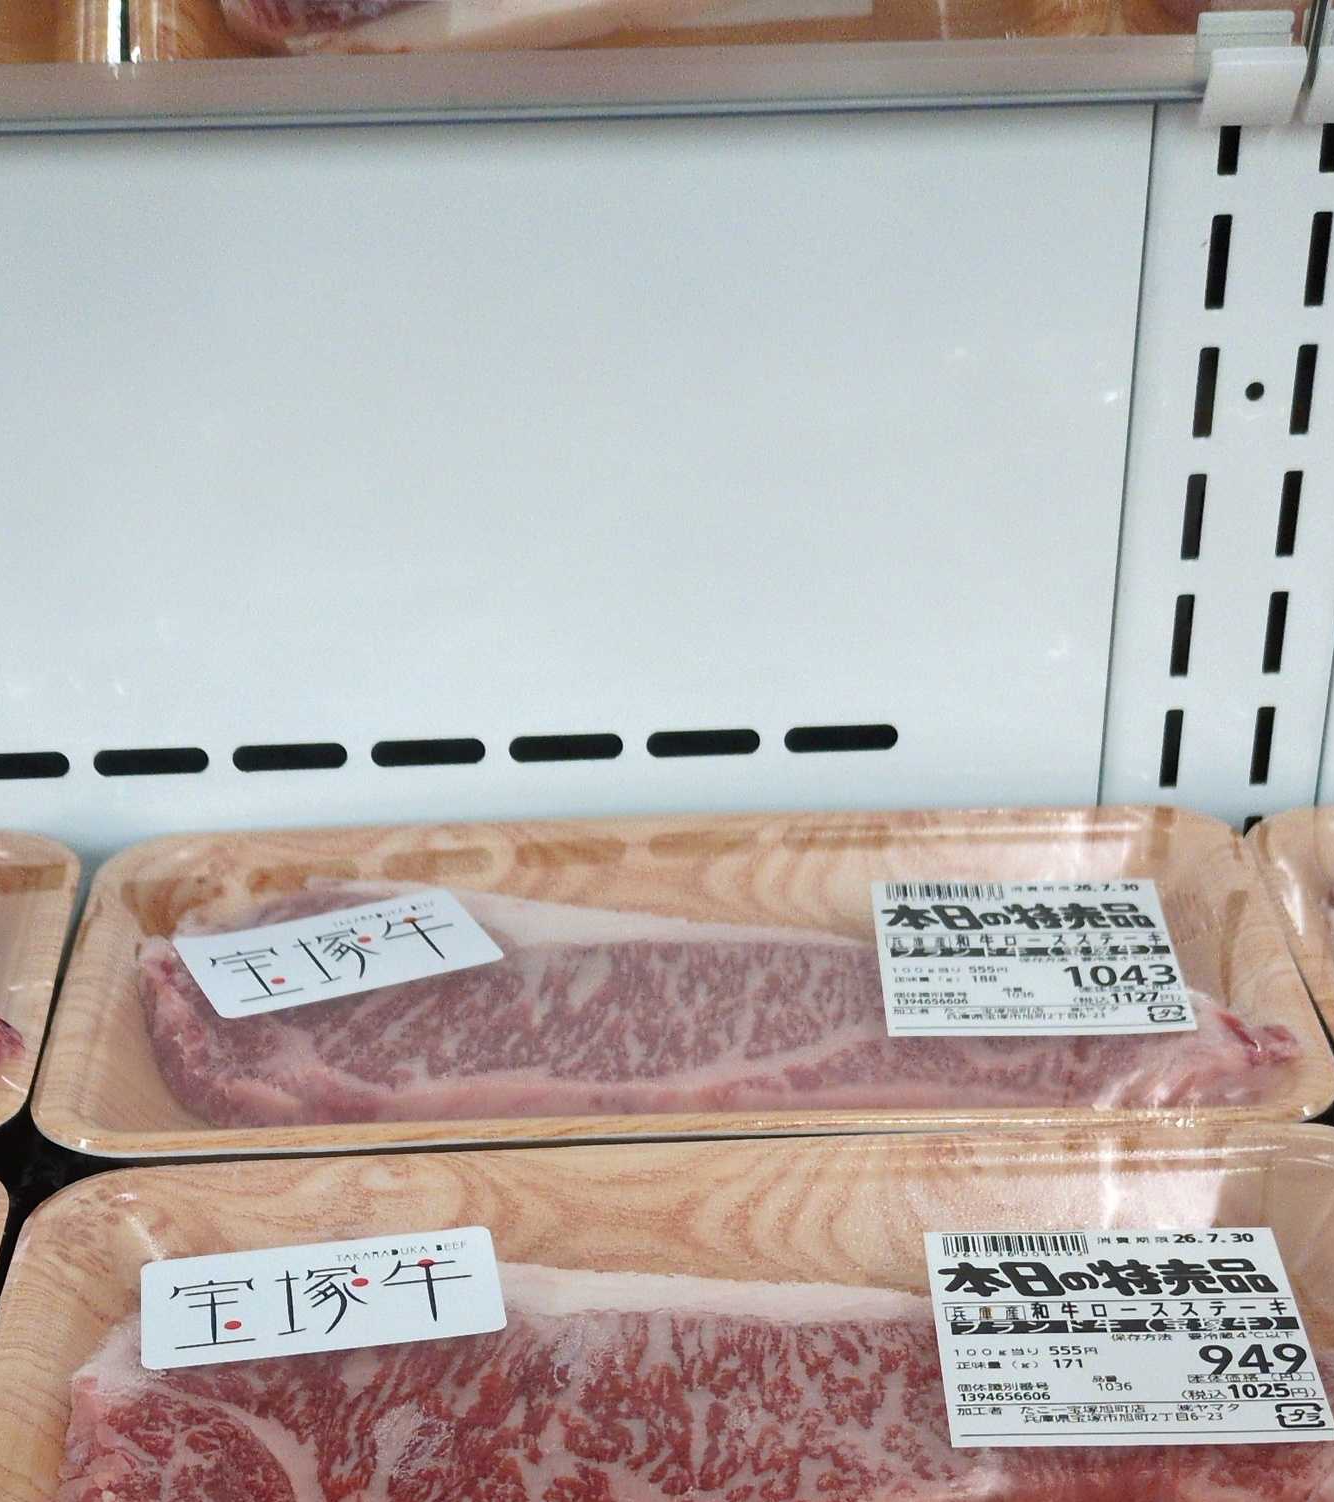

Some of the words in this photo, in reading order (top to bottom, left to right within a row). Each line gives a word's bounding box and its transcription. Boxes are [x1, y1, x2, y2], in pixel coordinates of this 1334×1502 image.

[1074, 882, 1140, 893] 26.7.30
[881, 902, 1157, 930] 本日の特売品
[210, 915, 454, 1002] 宝塚牛
[1063, 964, 1178, 988] 1043
[1172, 1232, 1255, 1245] 26.7.30
[335, 1245, 429, 1263] TAKARADUKA
[938, 1258, 1280, 1297] 本日の特売品
[169, 1258, 472, 1350] 宝塚牛
[1052, 1358, 1084, 1369] 171
[1198, 1343, 1308, 1376] 949
